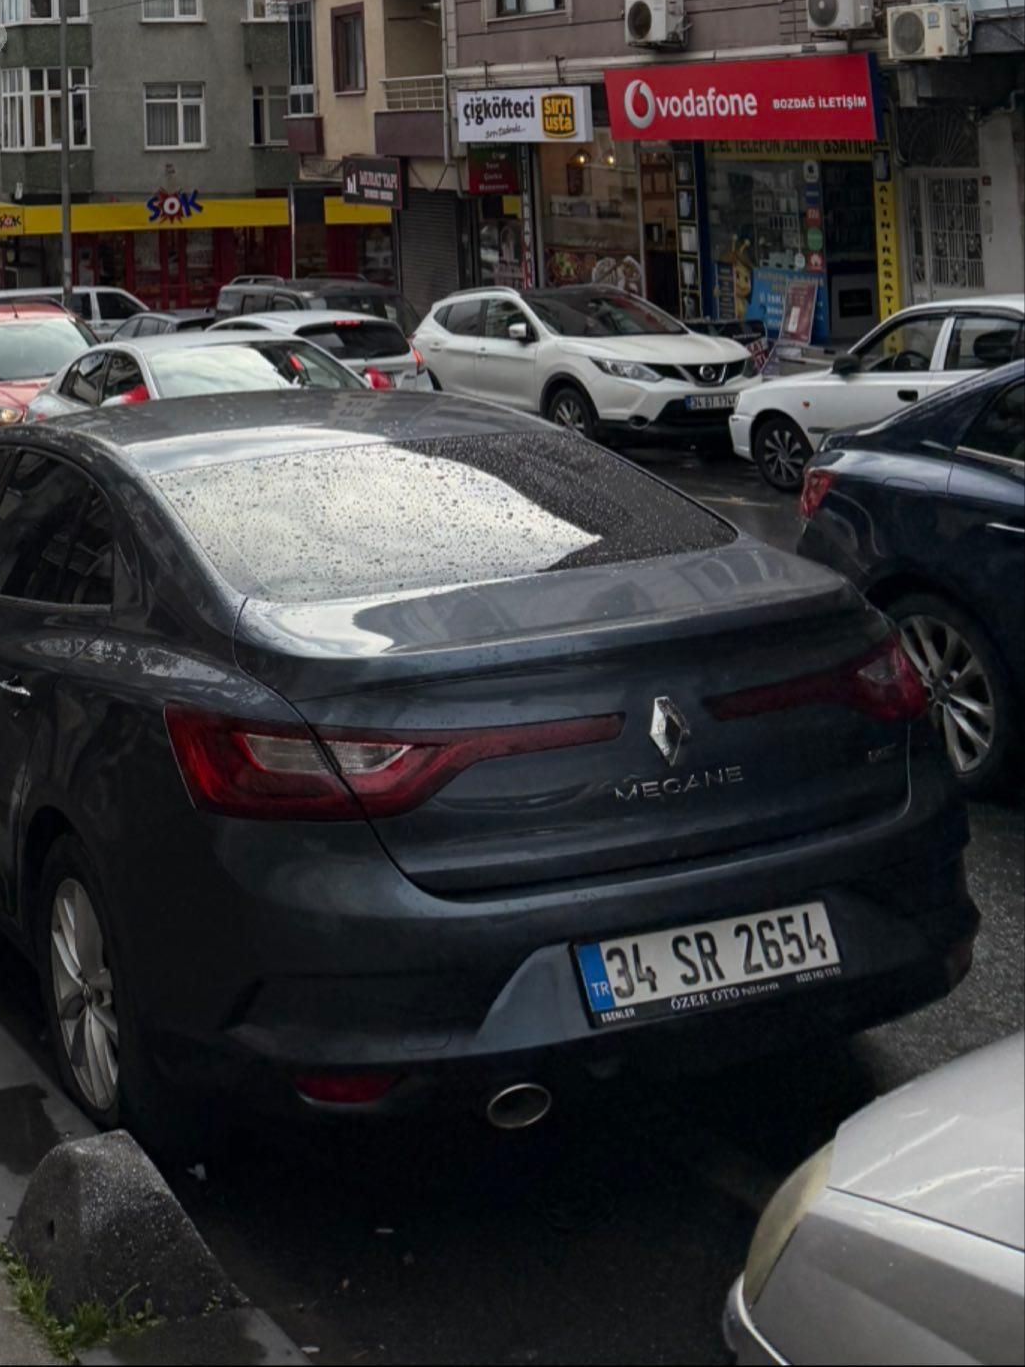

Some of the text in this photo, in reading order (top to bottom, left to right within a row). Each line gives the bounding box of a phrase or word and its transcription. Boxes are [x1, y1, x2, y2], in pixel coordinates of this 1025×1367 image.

[463, 96, 536, 126] çiğköfteci
[656, 87, 867, 118] vodafone BOZDAĞ İLETİŞİM
[544, 115, 573, 132] usta
[614, 765, 744, 802] MEGANE
[605, 912, 828, 999] 34 SR 2654
[591, 982, 611, 998] TR
[670, 992, 710, 1011] ÖZER
[711, 986, 741, 1003] OTO
